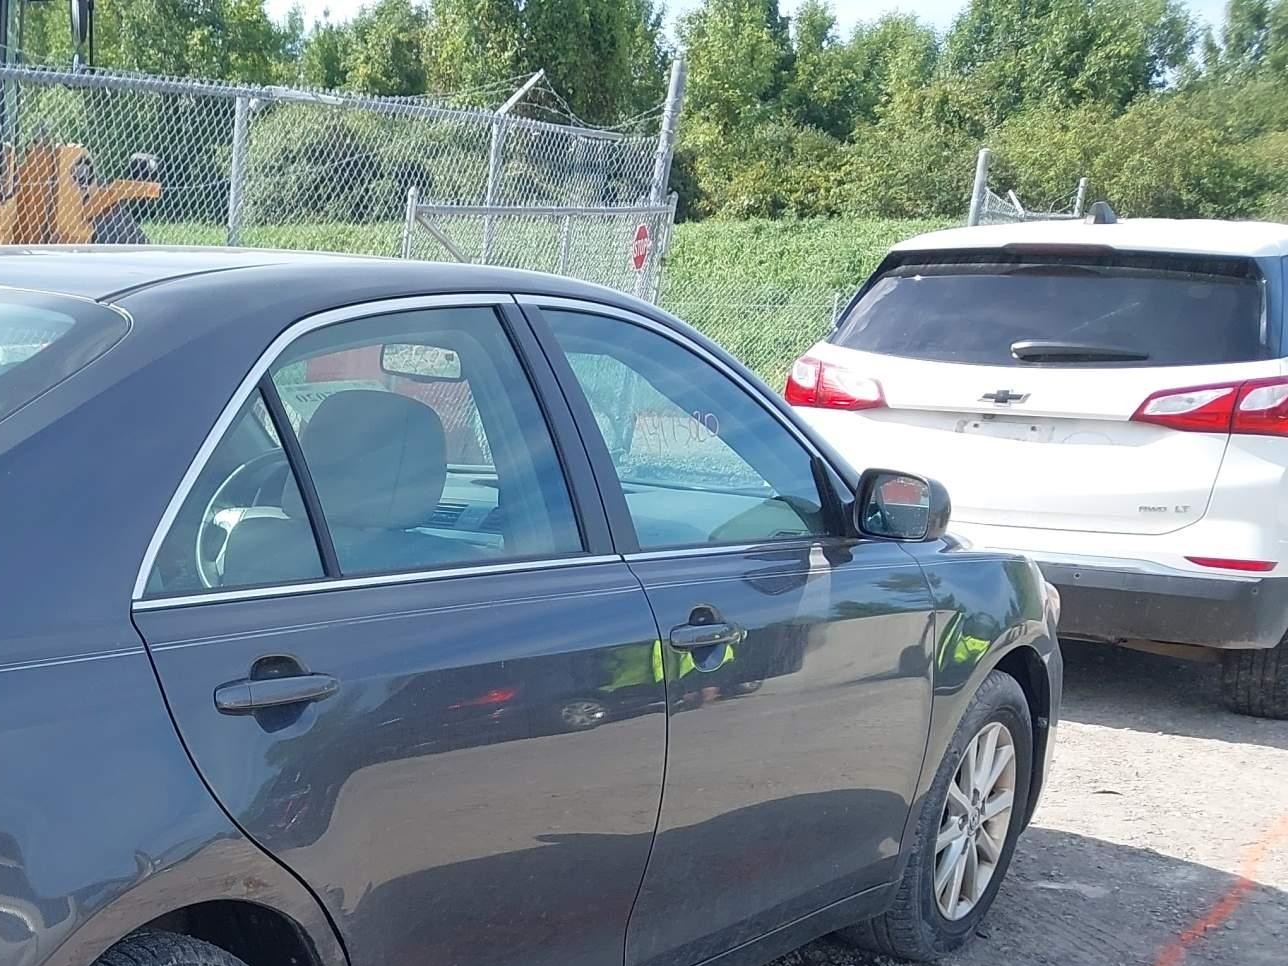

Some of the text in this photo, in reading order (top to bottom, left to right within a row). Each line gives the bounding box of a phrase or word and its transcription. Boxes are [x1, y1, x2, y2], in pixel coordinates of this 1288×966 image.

[633, 238, 649, 258] STOP
[1138, 505, 1192, 513] AWD LT
